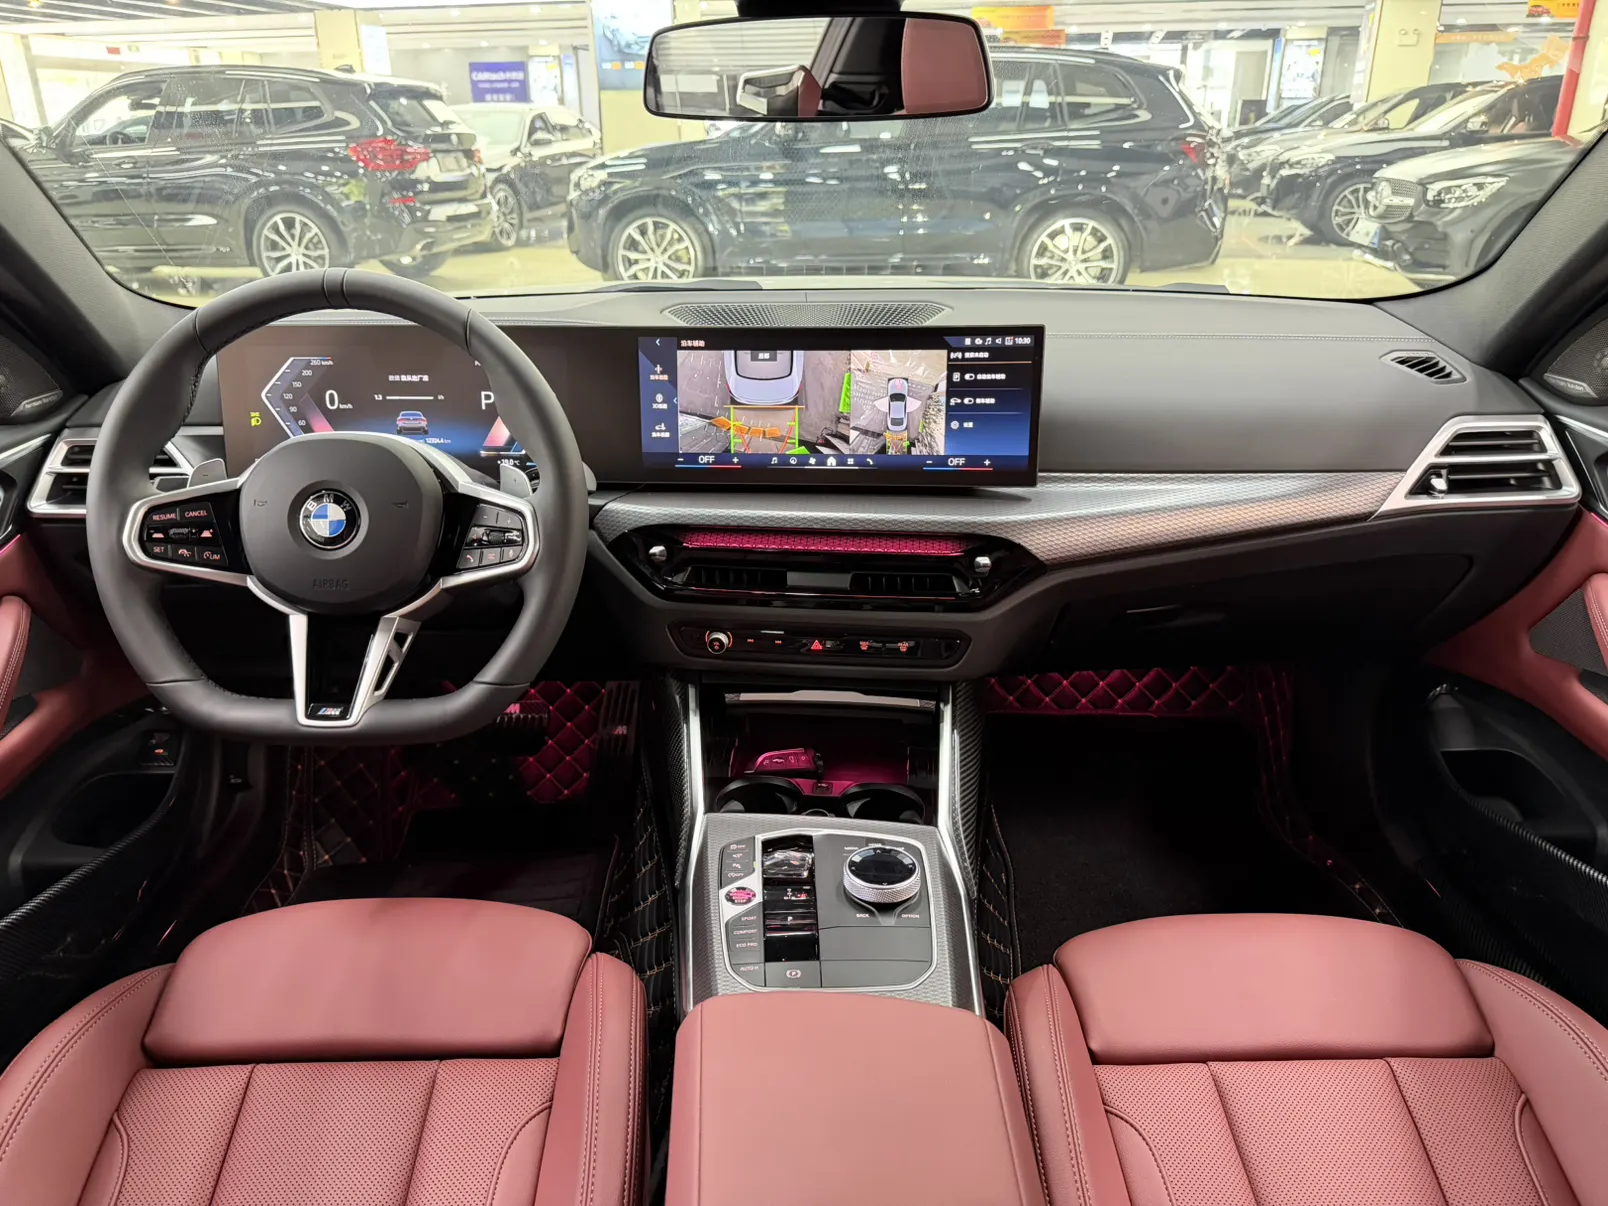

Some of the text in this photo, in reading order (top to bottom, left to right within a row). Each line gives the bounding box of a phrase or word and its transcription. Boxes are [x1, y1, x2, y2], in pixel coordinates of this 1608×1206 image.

[302, 369, 312, 377] 200
[325, 389, 339, 410] 0
[480, 391, 495, 410] P
[698, 455, 715, 464] OFF
[948, 457, 966, 466] OFF
[306, 493, 352, 512] BMW
[152, 512, 177, 521] RESUME
[184, 509, 208, 518] CANCEL
[312, 578, 350, 591] AIRBAG
